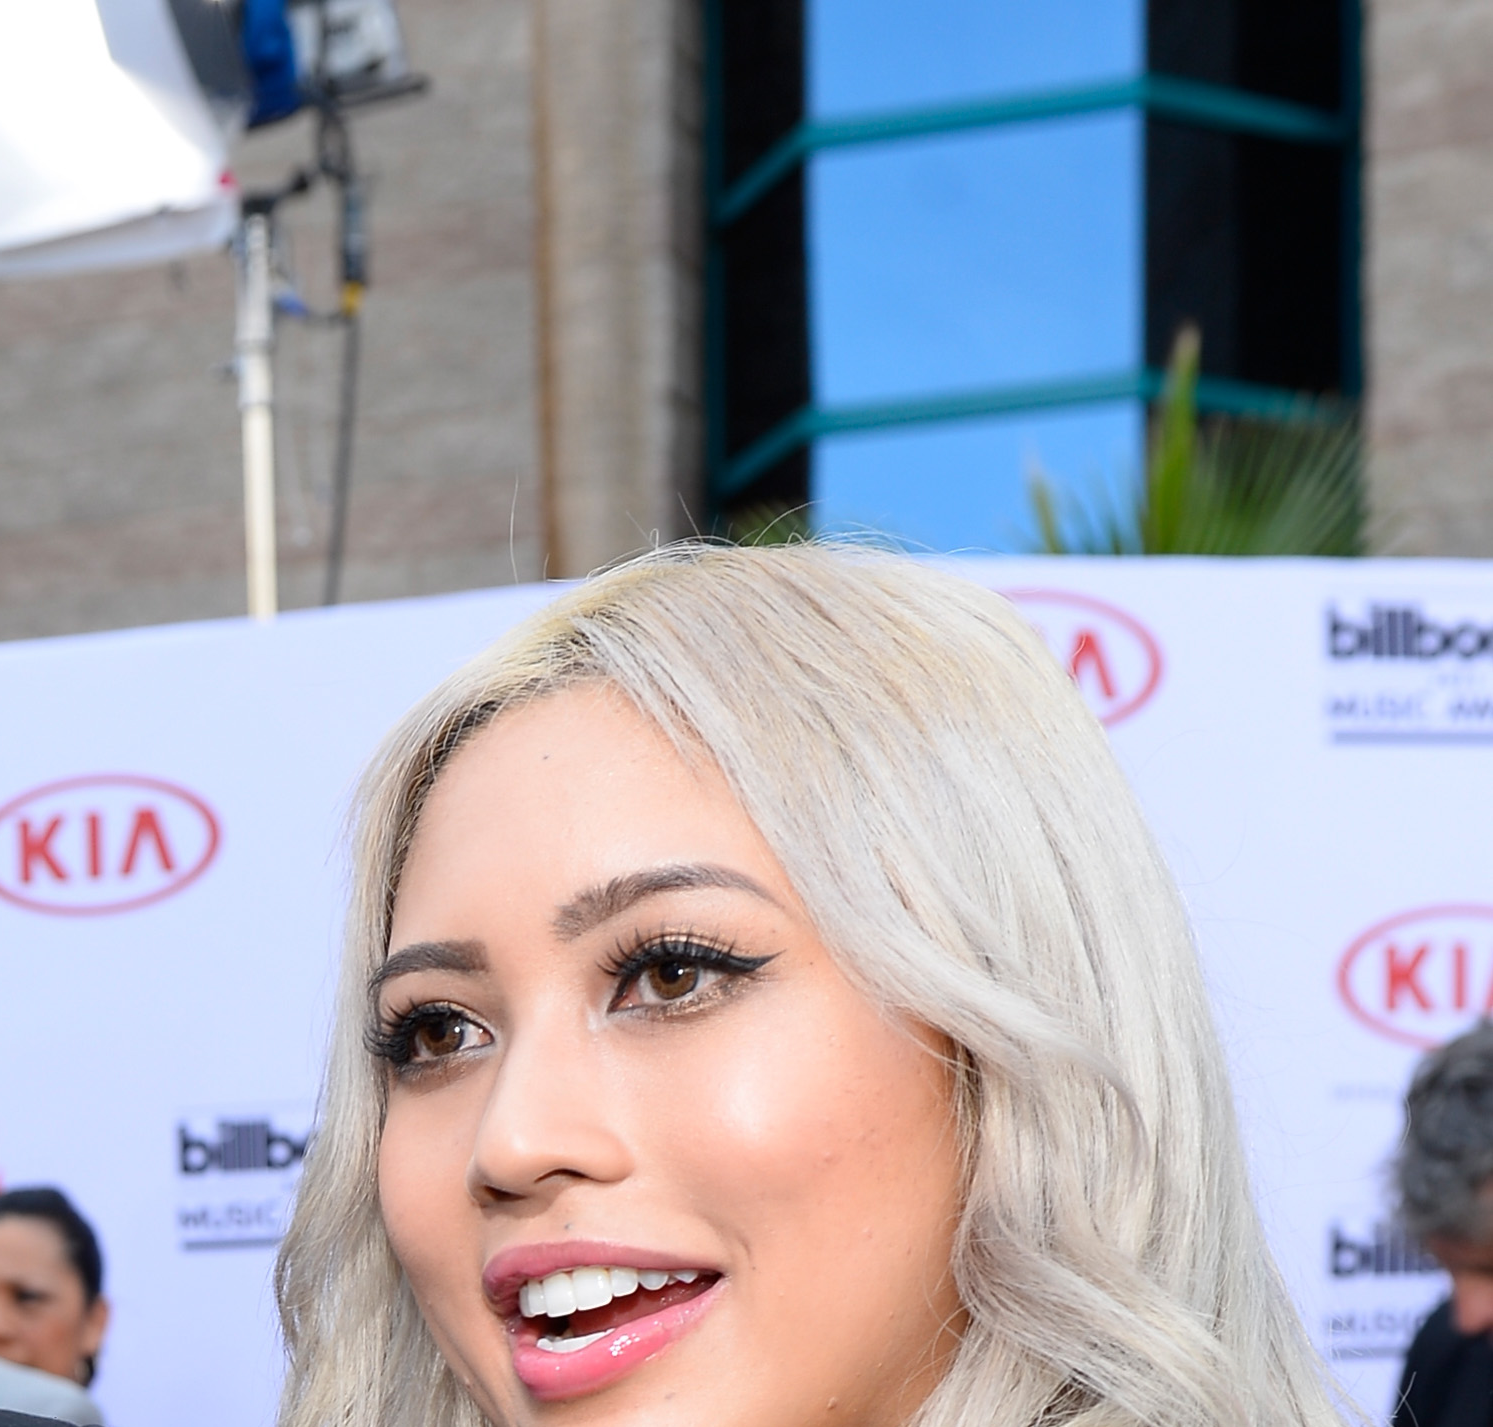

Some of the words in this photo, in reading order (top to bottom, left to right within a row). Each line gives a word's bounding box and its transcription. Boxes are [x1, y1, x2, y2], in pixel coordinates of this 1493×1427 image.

[1327, 606, 1493, 660] billbo
[17, 807, 176, 887] KIA
[1384, 944, 1493, 1013] KI
